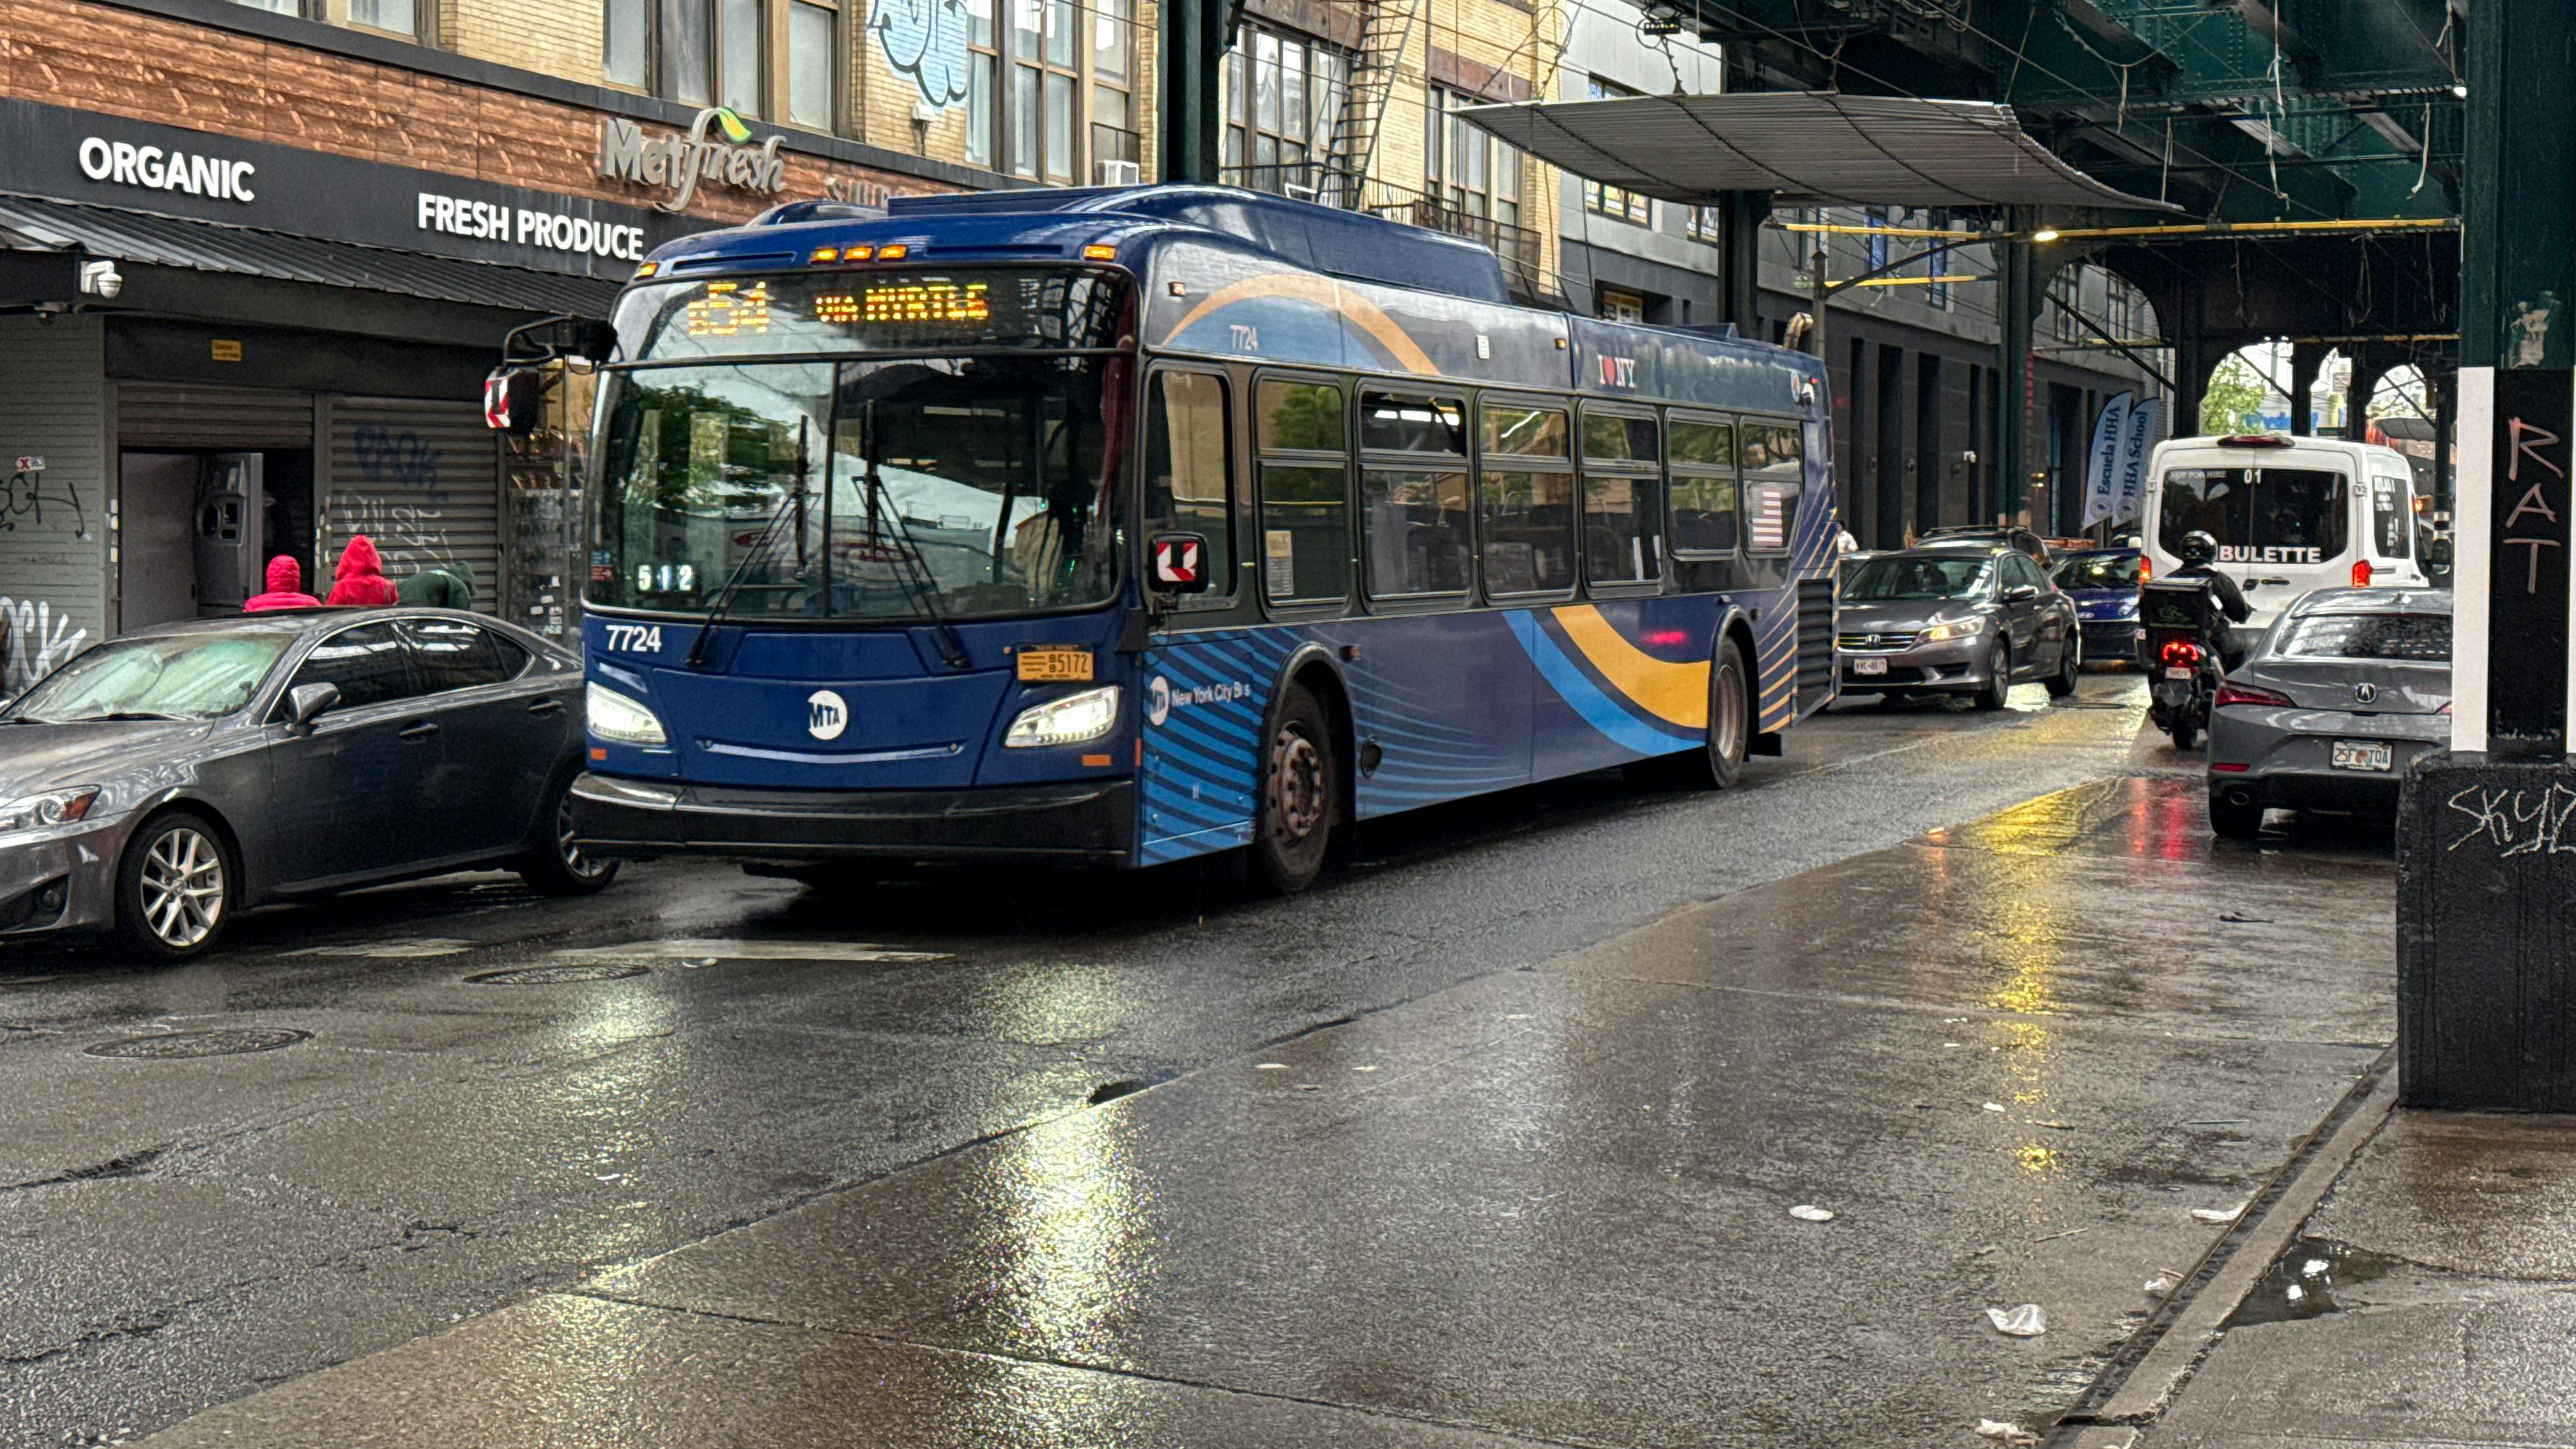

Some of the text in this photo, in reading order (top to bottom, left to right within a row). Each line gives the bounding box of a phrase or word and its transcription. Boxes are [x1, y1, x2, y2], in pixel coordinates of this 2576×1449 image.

[79, 137, 255, 202] ORGANIC
[417, 193, 644, 261] FRESH PRODUCE
[1229, 325, 1259, 351] 7724
[1614, 356, 1637, 388] NY
[2097, 406, 2120, 494] Escuela HHA
[2123, 411, 2148, 497] HHA School
[2244, 468, 2262, 484] 01
[2503, 417, 2564, 594] RAT
[2219, 545, 2321, 563] BULETTE
[606, 625, 662, 653] 7724
[1057, 654, 1088, 673] 5172
[1172, 681, 1250, 707] New York City Bs
[808, 702, 841, 728] MTA
